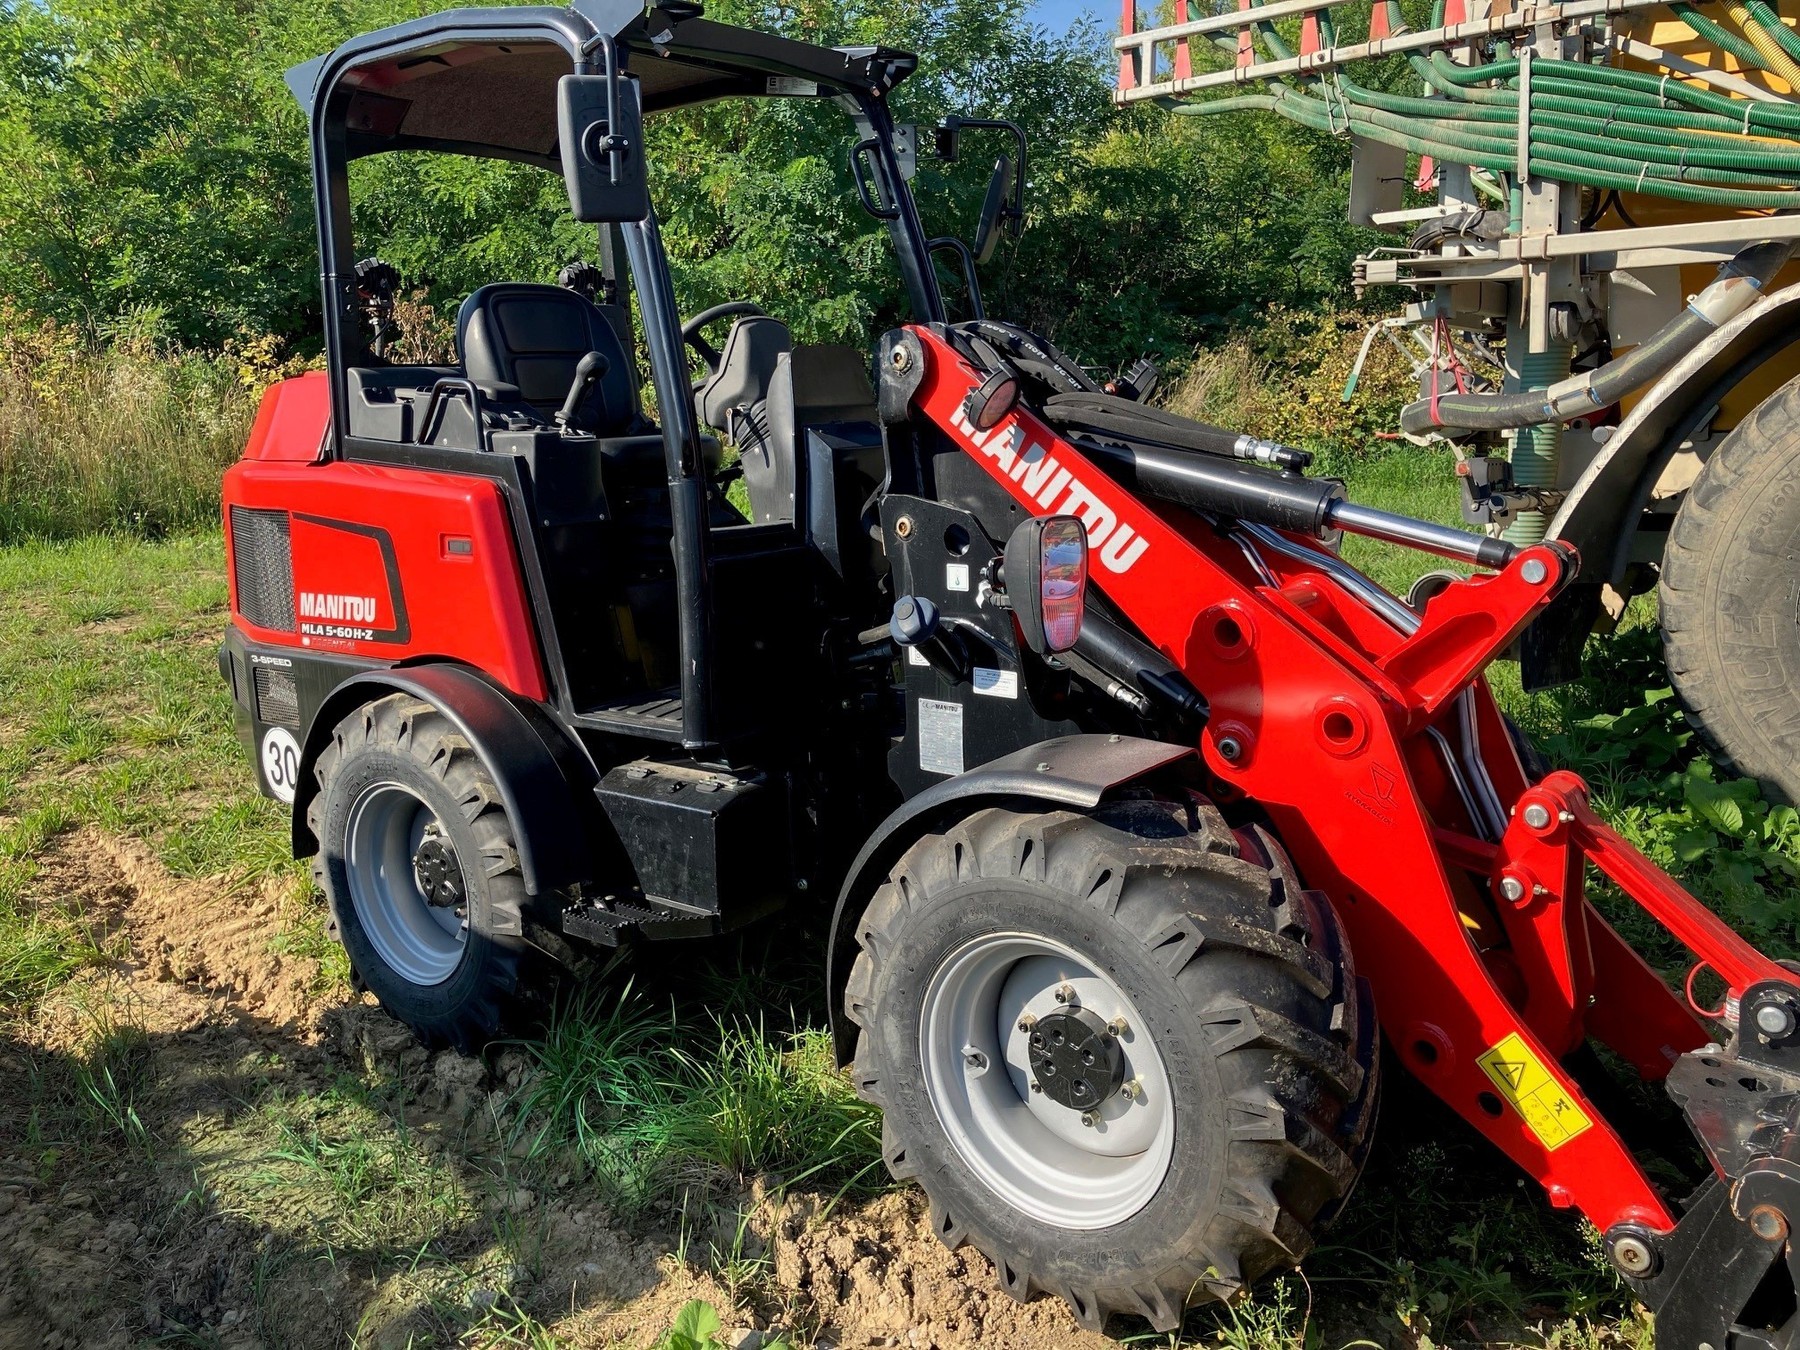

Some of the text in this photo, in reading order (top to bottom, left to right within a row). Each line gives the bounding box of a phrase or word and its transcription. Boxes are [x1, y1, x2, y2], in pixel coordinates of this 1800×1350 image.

[300, 592, 376, 623] MANITOU
[301, 623, 324, 636] MLA
[251, 654, 292, 667] 3-SPEED
[935, 703, 959, 713] MANITOU
[269, 740, 299, 791] 30
